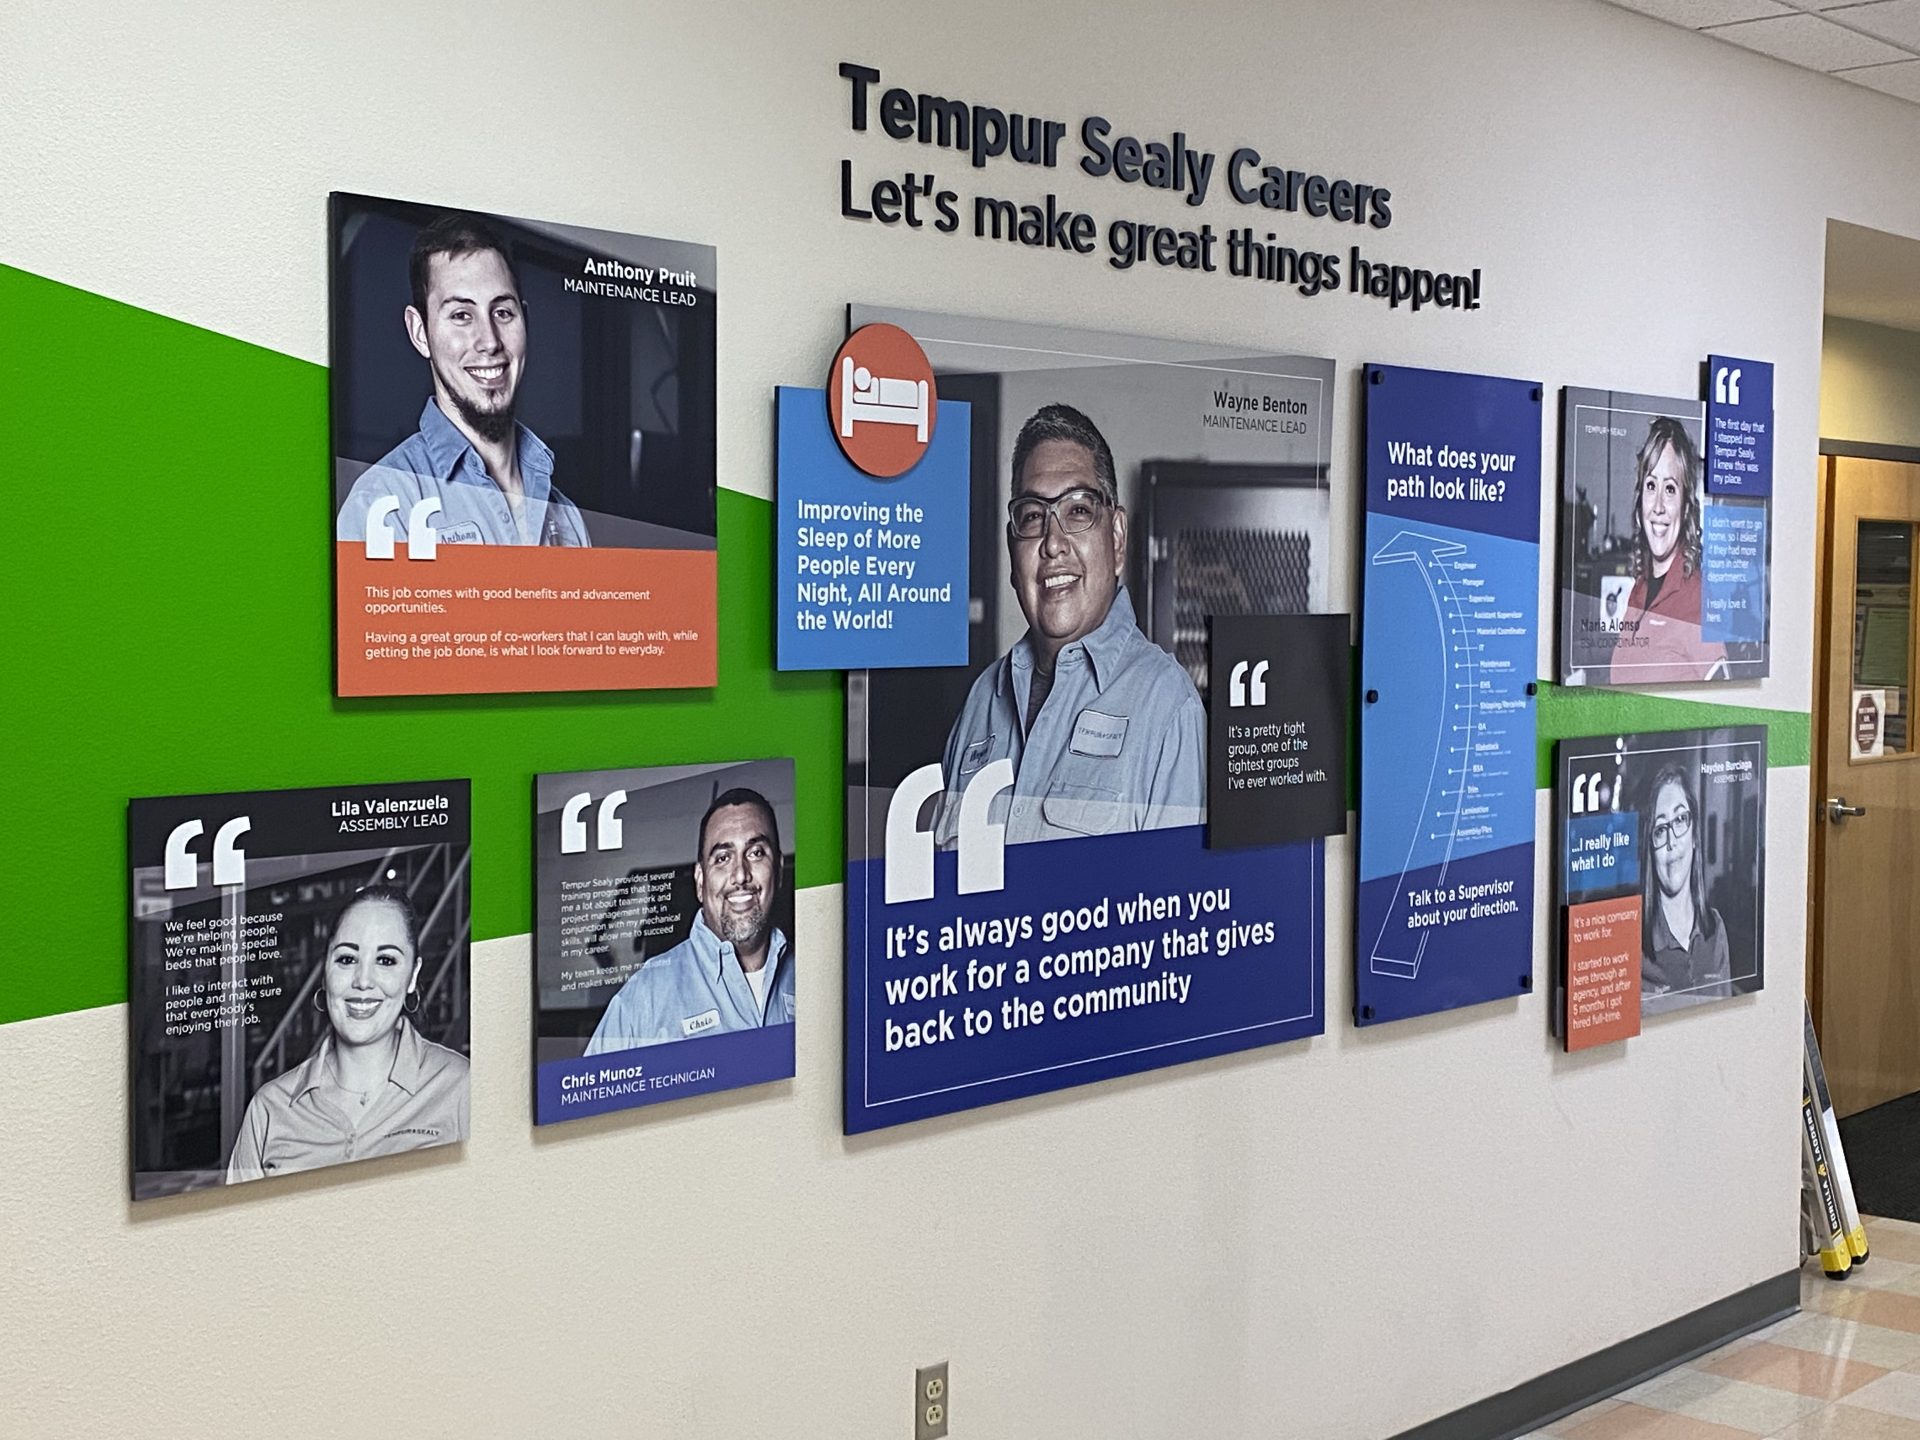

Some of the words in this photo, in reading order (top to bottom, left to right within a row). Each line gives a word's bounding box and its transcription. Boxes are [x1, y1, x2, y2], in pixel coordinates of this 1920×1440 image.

[839, 62, 1065, 168] Tempur
[1080, 116, 1215, 206] Sealy
[1228, 148, 1392, 229] Careers
[840, 160, 959, 232] Let's
[974, 194, 1096, 255] make
[1109, 218, 1217, 272] great
[1228, 228, 1341, 296] things
[1350, 246, 1482, 311] happen!
[584, 258, 653, 285] Anthony
[659, 268, 696, 288] Pruit
[564, 278, 660, 303] MAINTENANCE
[663, 291, 696, 306] LEAD
[1214, 391, 1258, 412] Wayne
[1263, 396, 1307, 415] Benton
[1203, 414, 1278, 432] MAINTENANCE
[1281, 421, 1306, 434] LEAD
[1715, 418, 1726, 429] The
[1728, 419, 1739, 430] first
[1741, 421, 1751, 433] day
[1753, 422, 1764, 432] that
[1718, 433, 1742, 444] stepped
[1744, 434, 1755, 445] into
[1387, 441, 1433, 466] What
[1438, 445, 1476, 469] does
[1481, 453, 1516, 474] your
[1387, 475, 1424, 501] path
[1430, 476, 1465, 500] look
[1470, 478, 1505, 502] like?
[798, 499, 890, 525] Improving
[896, 503, 923, 522] the
[798, 527, 848, 551] Sleep
[854, 528, 872, 548] of
[878, 529, 921, 549] More
[798, 555, 860, 578] People
[866, 556, 915, 579] Every
[365, 586, 389, 599] This
[392, 586, 411, 600] job
[414, 589, 452, 599] comes
[455, 587, 479, 599] with
[482, 587, 511, 601] good
[514, 587, 557, 600] benefits
[560, 588, 579, 600] and
[582, 588, 650, 600] advancement
[798, 582, 852, 606] Night,
[858, 583, 881, 602] All
[888, 583, 950, 602] Around
[365, 601, 447, 614] opportunities.
[797, 610, 827, 630] the
[833, 610, 893, 630] World!
[1581, 619, 1606, 631] Maria
[1609, 619, 1639, 631] Alonso
[365, 631, 407, 645] Having
[410, 634, 417, 643] a
[420, 632, 451, 645] great
[453, 633, 487, 645] group
[491, 631, 501, 642] of
[504, 631, 563, 642] co-workers
[566, 631, 587, 642] that
[596, 633, 614, 641] can
[617, 630, 645, 644] laugh
[647, 630, 671, 643] with,
[673, 630, 698, 641] while
[1229, 726, 1242, 738] It's
[1245, 728, 1250, 737] a
[1253, 724, 1281, 739] pretty
[1284, 722, 1305, 737] tight
[1229, 743, 1259, 758] group,
[1262, 742, 1278, 753] one
[1281, 739, 1291, 751] of
[1293, 738, 1308, 750] the
[1229, 759, 1264, 775] tightest
[1267, 757, 1299, 771] groups
[1229, 777, 1244, 790] I've
[1247, 776, 1267, 788] ever
[1270, 771, 1303, 786] worked
[1306, 769, 1328, 782] with.
[332, 801, 360, 816] Lila
[365, 795, 448, 814] Valenzuela
[339, 816, 409, 833] ASSEMBLY
[413, 813, 448, 827] LEAD
[1585, 833, 1611, 851] really
[1614, 832, 1629, 846] like
[1572, 856, 1594, 872] what
[1597, 855, 1601, 867] I
[1602, 854, 1614, 867] do
[562, 881, 591, 890] Tempur
[592, 879, 613, 888] Sealy
[615, 874, 648, 885] provided
[650, 871, 675, 880] several
[561, 893, 591, 902] training
[593, 888, 628, 899] programs
[631, 885, 646, 893] that
[647, 883, 671, 892] taught
[1408, 890, 1431, 907] Talk
[1435, 889, 1446, 903] to
[1449, 889, 1455, 902] a
[1459, 879, 1514, 901] Supervisor
[165, 922, 183, 931] We
[186, 919, 206, 929] feel
[209, 916, 236, 929] good
[240, 913, 283, 925] because
[939, 914, 1032, 952] always
[1041, 898, 1109, 943] good
[1117, 893, 1181, 926] when
[1189, 888, 1230, 920] you
[1408, 910, 1440, 928] about
[1443, 908, 1467, 926] your
[1470, 899, 1518, 918] direction.
[1586, 917, 1590, 926] a
[1592, 913, 1606, 925] nice
[1608, 910, 1638, 922] company
[165, 934, 194, 945] we're
[197, 930, 236, 942] helping
[240, 925, 278, 939] people.
[1574, 931, 1581, 943] to
[1583, 929, 1600, 941] work
[166, 947, 196, 958] We're
[200, 942, 238, 955] making
[241, 936, 277, 950] special
[166, 960, 192, 971] beds
[195, 957, 216, 967] that
[220, 952, 256, 966] people
[259, 950, 282, 960] love.
[885, 962, 958, 1006] work
[966, 958, 1007, 992] for
[1015, 960, 1030, 983] a
[1039, 938, 1155, 980] company
[1162, 927, 1209, 961] that
[1216, 919, 1275, 957] gives
[885, 1010, 955, 1052] back
[963, 1006, 993, 1035] to
[1001, 997, 1045, 1031] the
[1053, 971, 1191, 1021] community
[690, 1015, 712, 1031] Chris
[561, 1080, 645, 1105] MAINTENANCE
[649, 1067, 715, 1089] TECHNICIAN
[562, 1073, 595, 1090] Chris
[600, 1066, 642, 1083] Munoz
[1806, 1109, 1821, 1162] LADDERS
[1823, 1180, 1837, 1229] GORILLA
